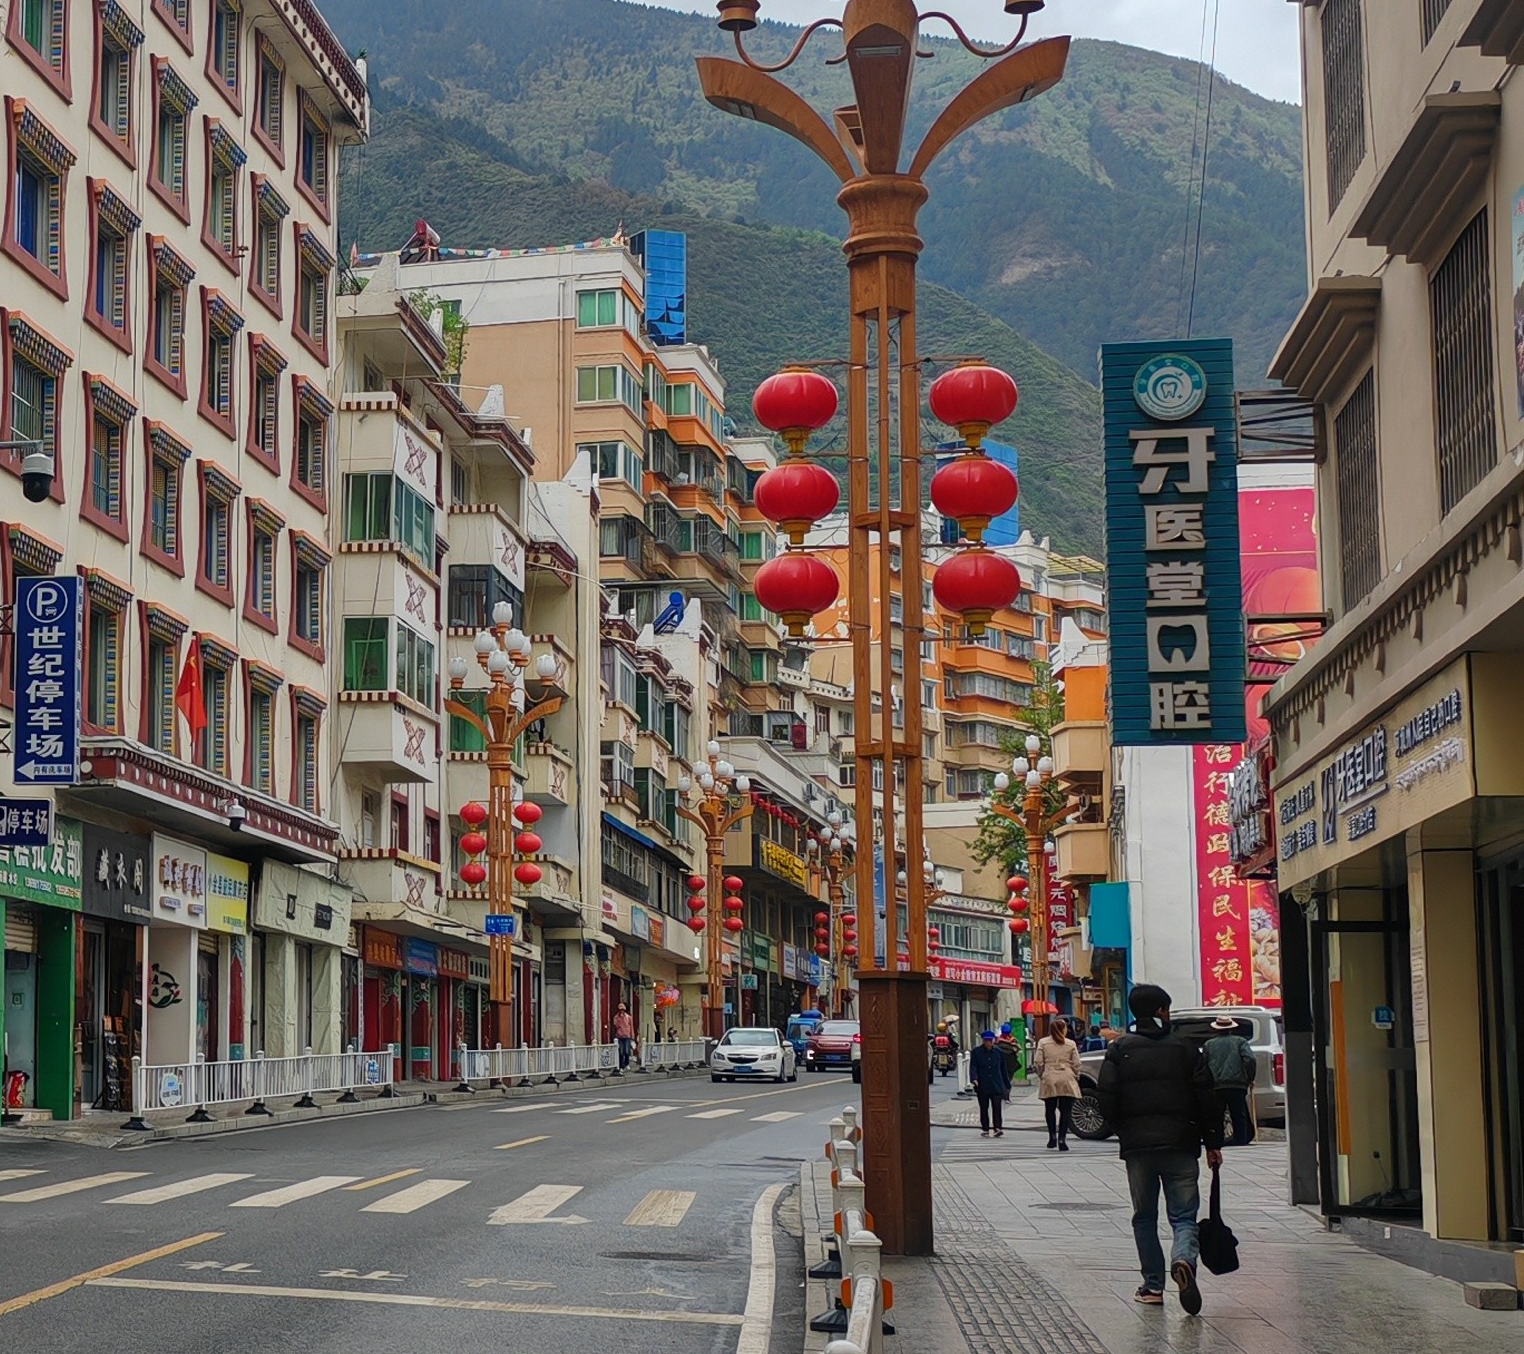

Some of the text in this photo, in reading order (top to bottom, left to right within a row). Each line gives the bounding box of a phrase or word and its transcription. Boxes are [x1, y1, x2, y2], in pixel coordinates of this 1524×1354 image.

[1128, 426, 1216, 729] 牙医堂口腔
[26, 626, 67, 758] 世纪停车场
[1336, 725, 1387, 803] 牙医堂口腔
[7, 808, 48, 835] 停车场
